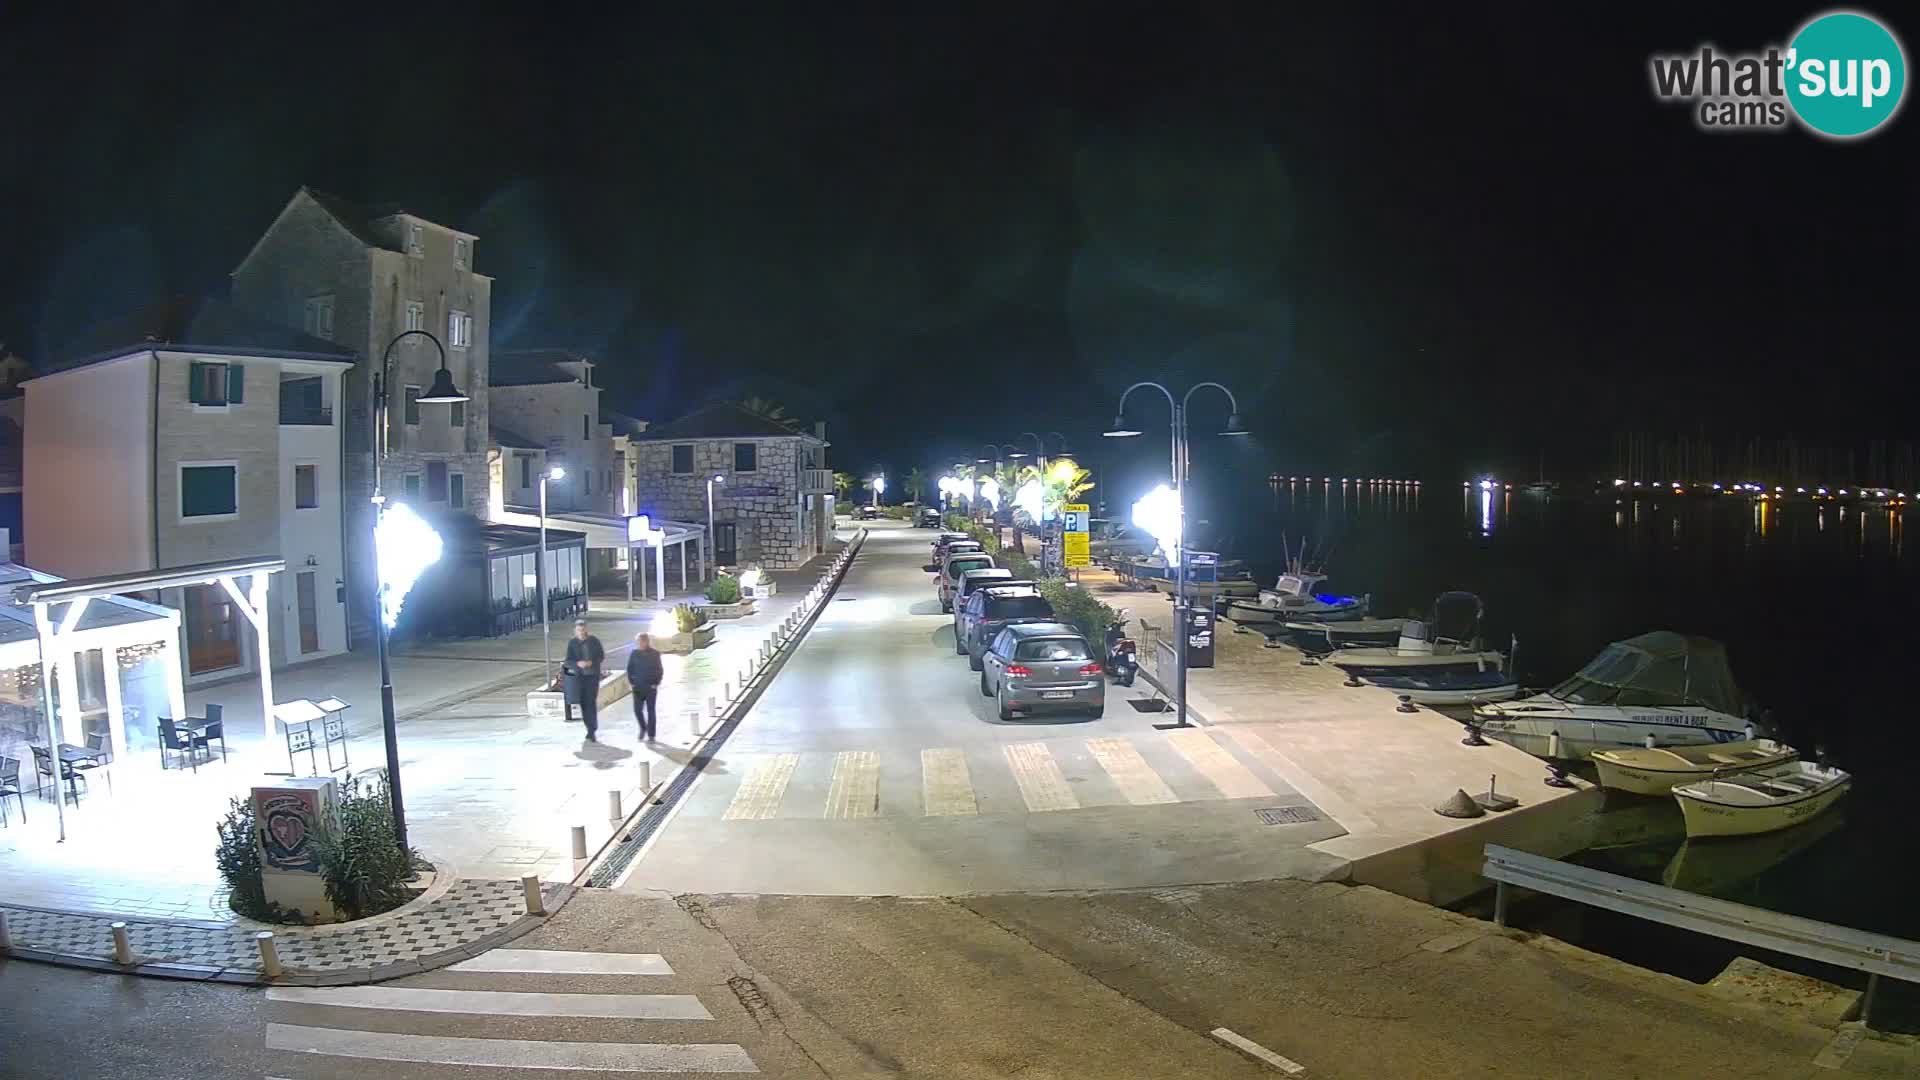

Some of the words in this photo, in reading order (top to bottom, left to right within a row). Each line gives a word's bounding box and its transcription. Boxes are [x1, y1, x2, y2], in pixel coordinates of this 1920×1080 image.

[1065, 514, 1076, 530] P
[1664, 715, 1683, 724] RENT
[1691, 716, 1708, 726] BOAT
